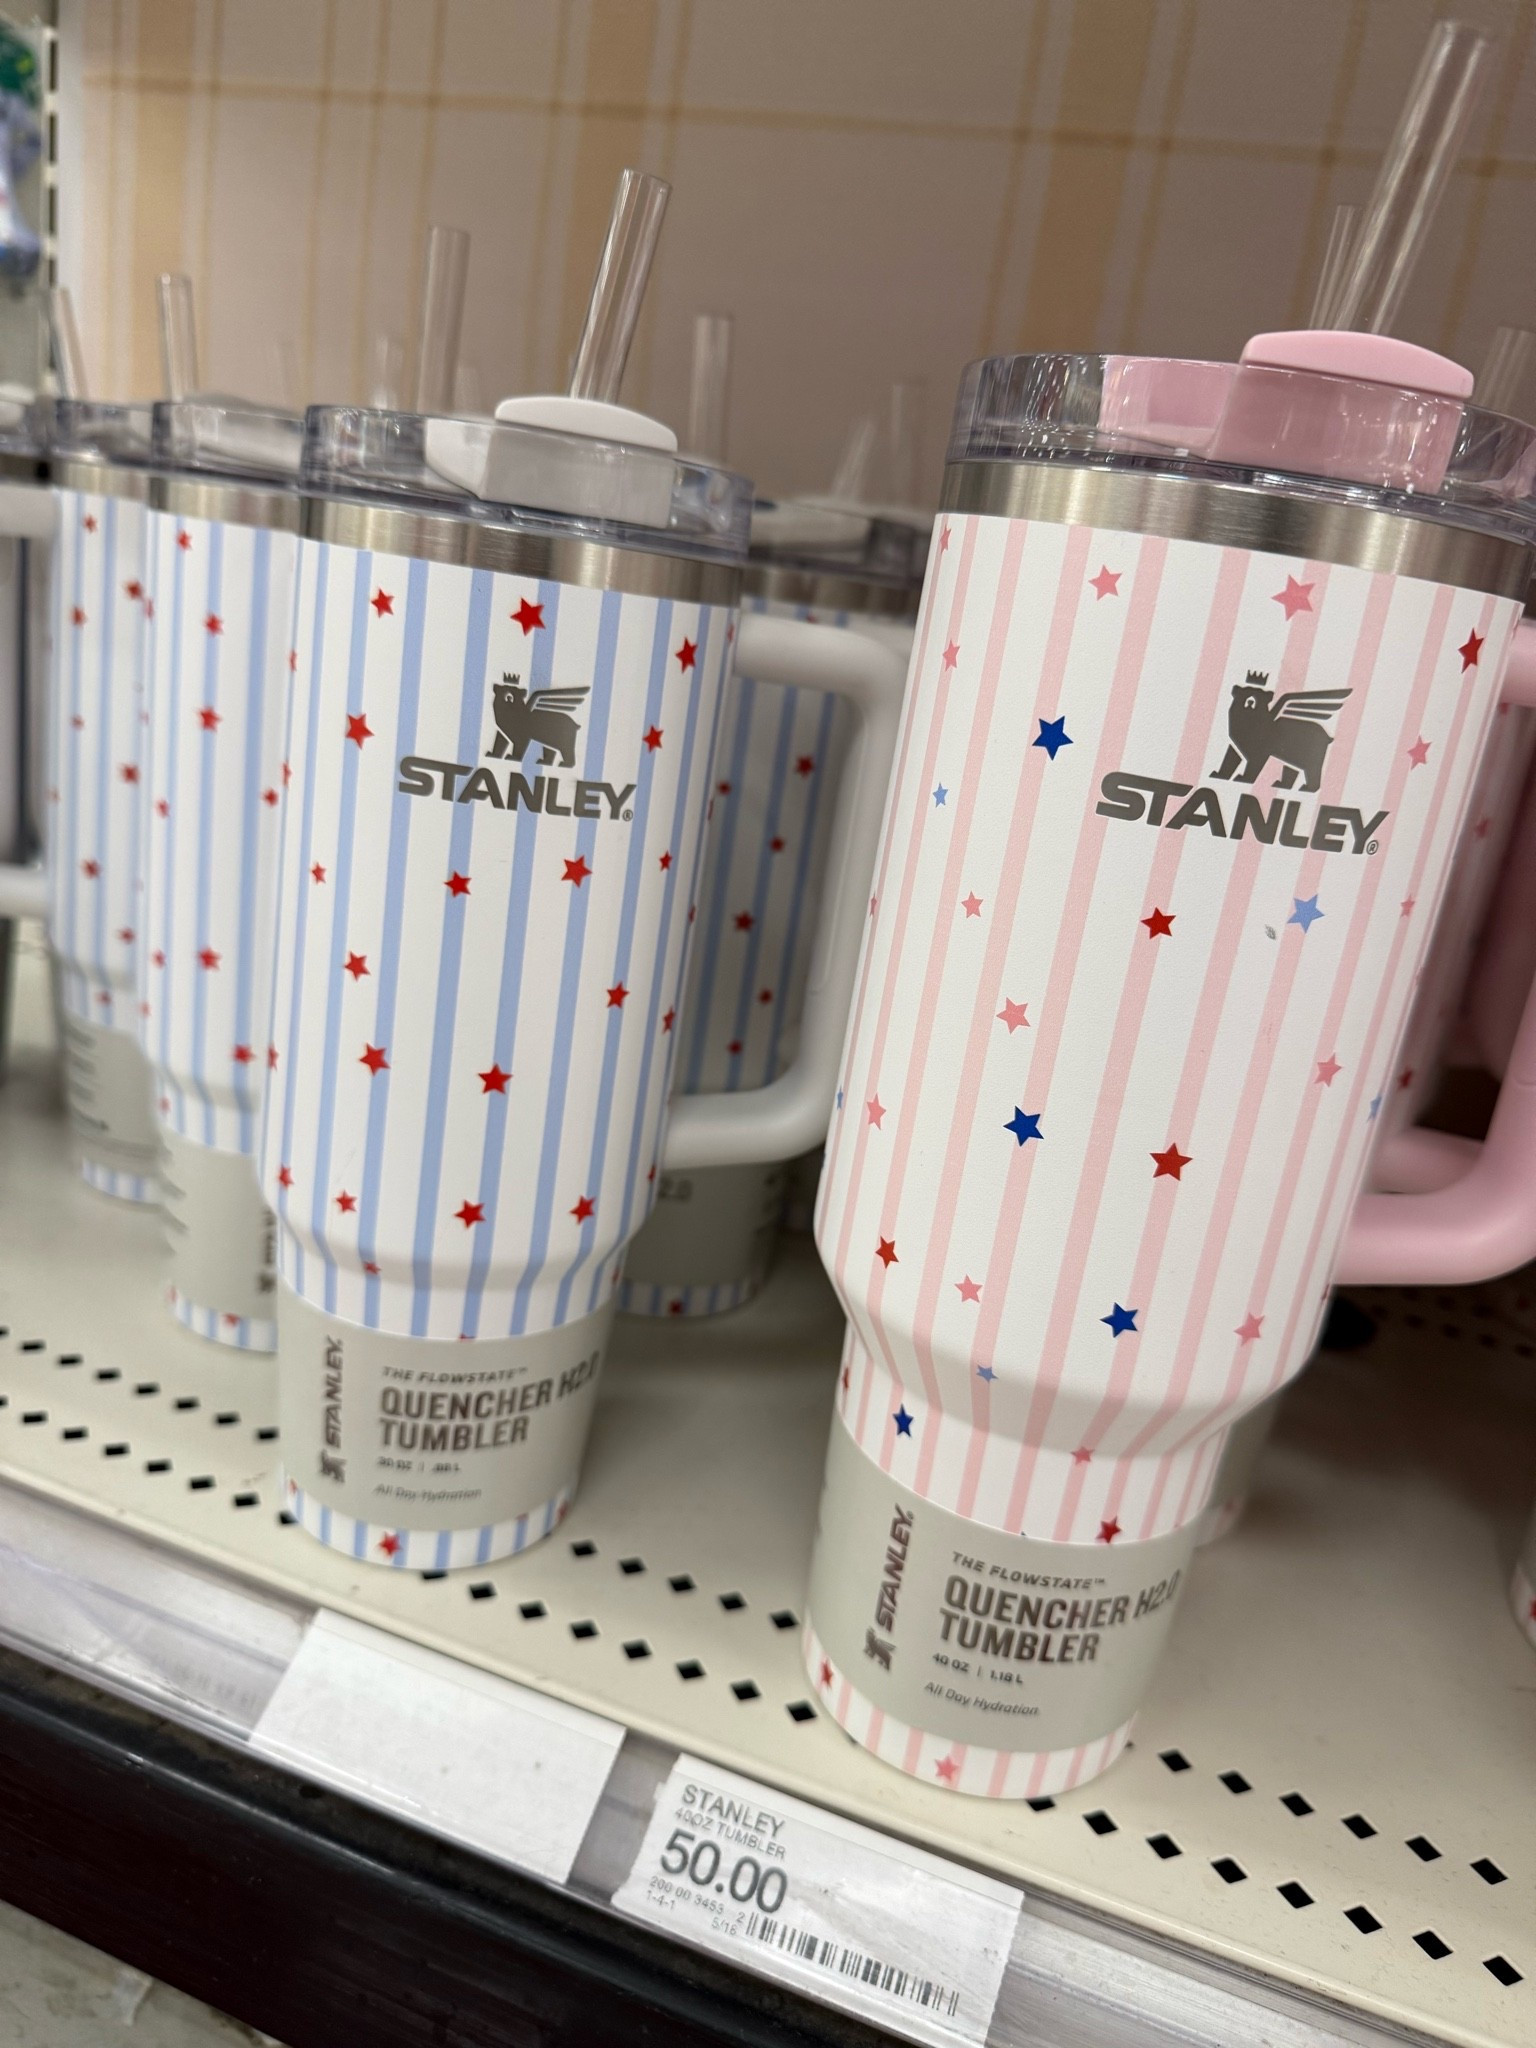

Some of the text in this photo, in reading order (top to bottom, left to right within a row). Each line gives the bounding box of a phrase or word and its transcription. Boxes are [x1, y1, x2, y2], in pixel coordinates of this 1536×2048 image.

[382, 1366, 415, 1381] THE
[381, 1377, 554, 1420] QUENCHER
[379, 1415, 530, 1452] TUMBLER
[952, 1551, 985, 1573] THE
[944, 1574, 1131, 1630] QUENCHER
[939, 1607, 1101, 1664] TUMBLER
[932, 1652, 950, 1667] 40
[951, 1658, 970, 1673] OZ
[924, 1681, 1039, 1716] All Day Hydration
[681, 1783, 786, 1838] STANLEY
[717, 1821, 787, 1861] TUMBLER
[660, 1826, 788, 1914] 50.00
